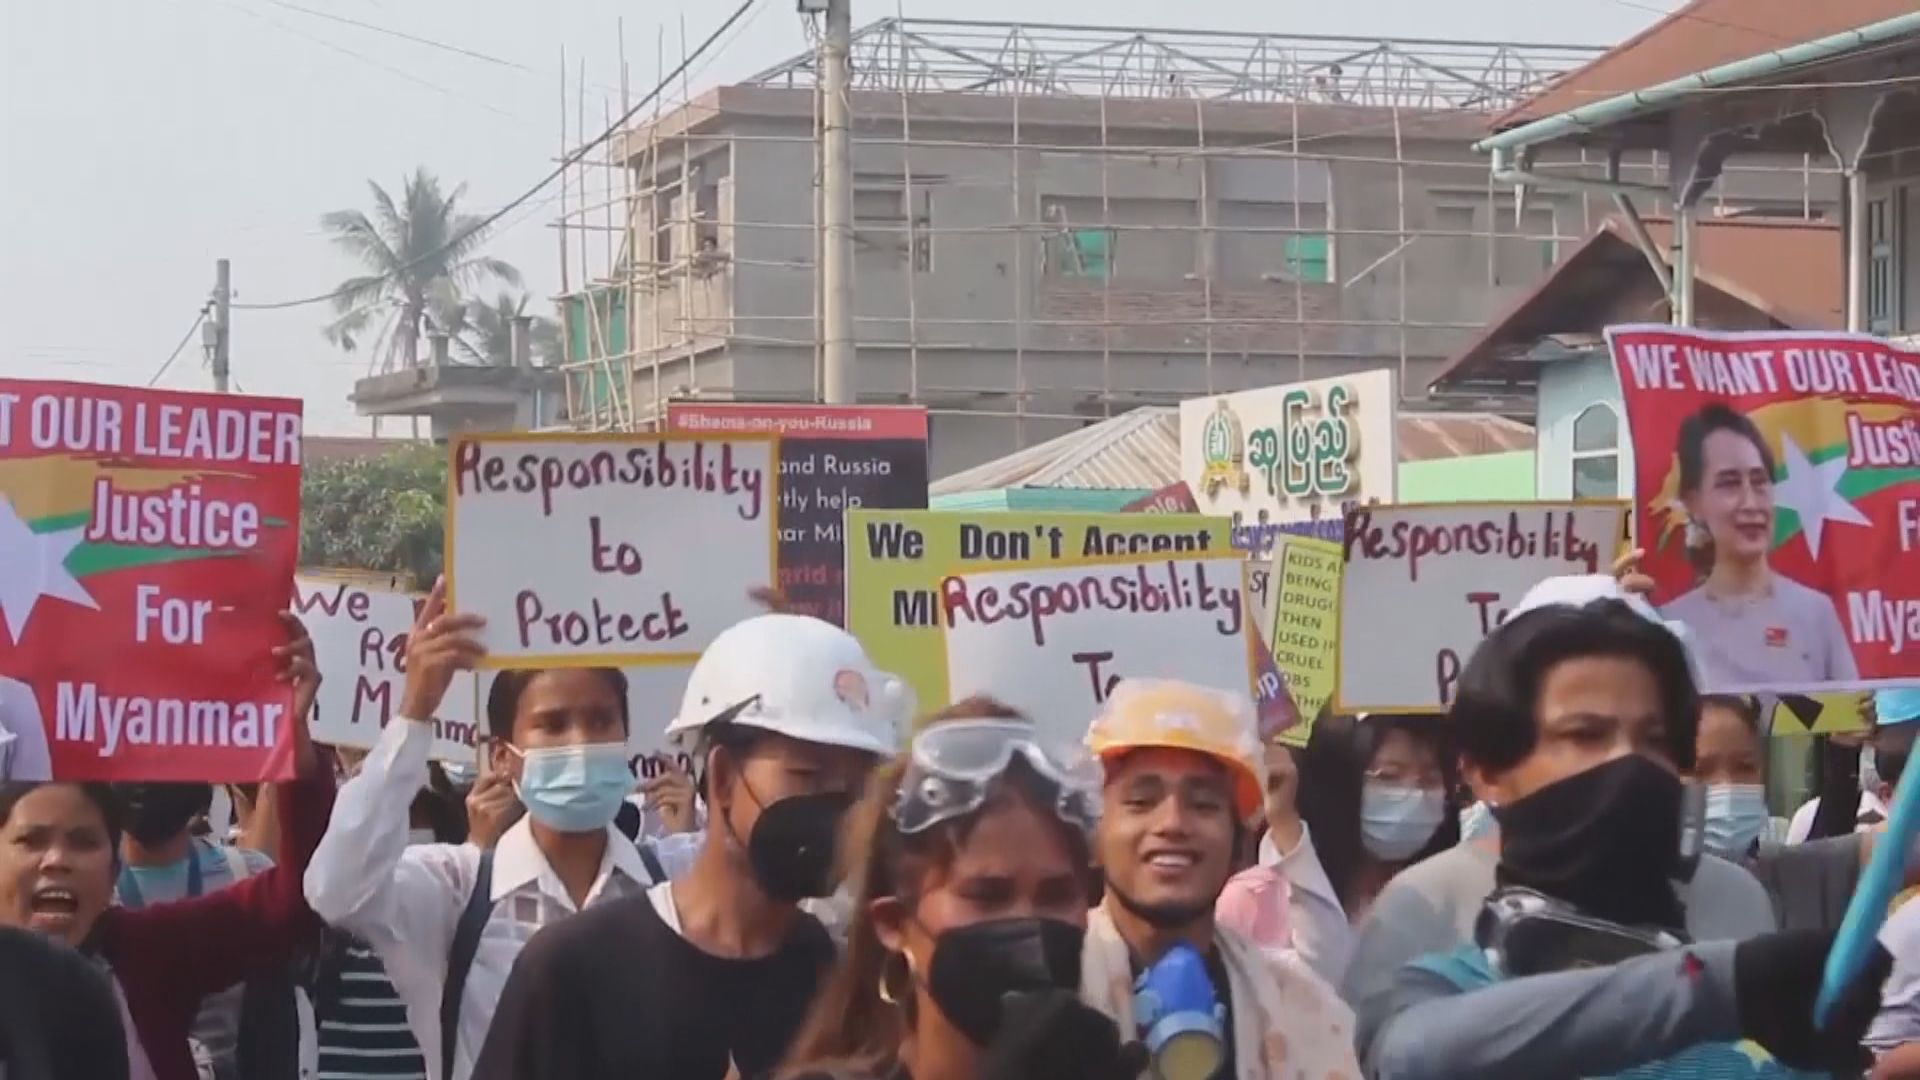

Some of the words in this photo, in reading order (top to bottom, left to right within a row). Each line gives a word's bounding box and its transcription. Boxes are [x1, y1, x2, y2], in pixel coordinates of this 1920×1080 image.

[1625, 345, 1684, 389] WE
[1682, 347, 1778, 395] WANT
[1784, 350, 1857, 393] OUR
[31, 396, 121, 453] OUR
[135, 402, 300, 465] LEADER
[455, 441, 762, 521] Responsibility
[824, 455, 891, 476] Russia
[89, 481, 259, 547] Justice
[867, 523, 924, 560] We
[960, 523, 1063, 560] Don't
[589, 516, 643, 575] to
[1288, 552, 1323, 570] KIDS
[1343, 509, 1600, 581] Responsibility
[942, 560, 1243, 646] Responsibility
[1285, 572, 1333, 592] BEING
[135, 585, 212, 645] For
[516, 591, 690, 647] Protect
[1278, 631, 1319, 649] USED
[1281, 611, 1323, 629] THEN
[1276, 651, 1323, 670] CRUEL
[55, 681, 283, 757] Myanmar
